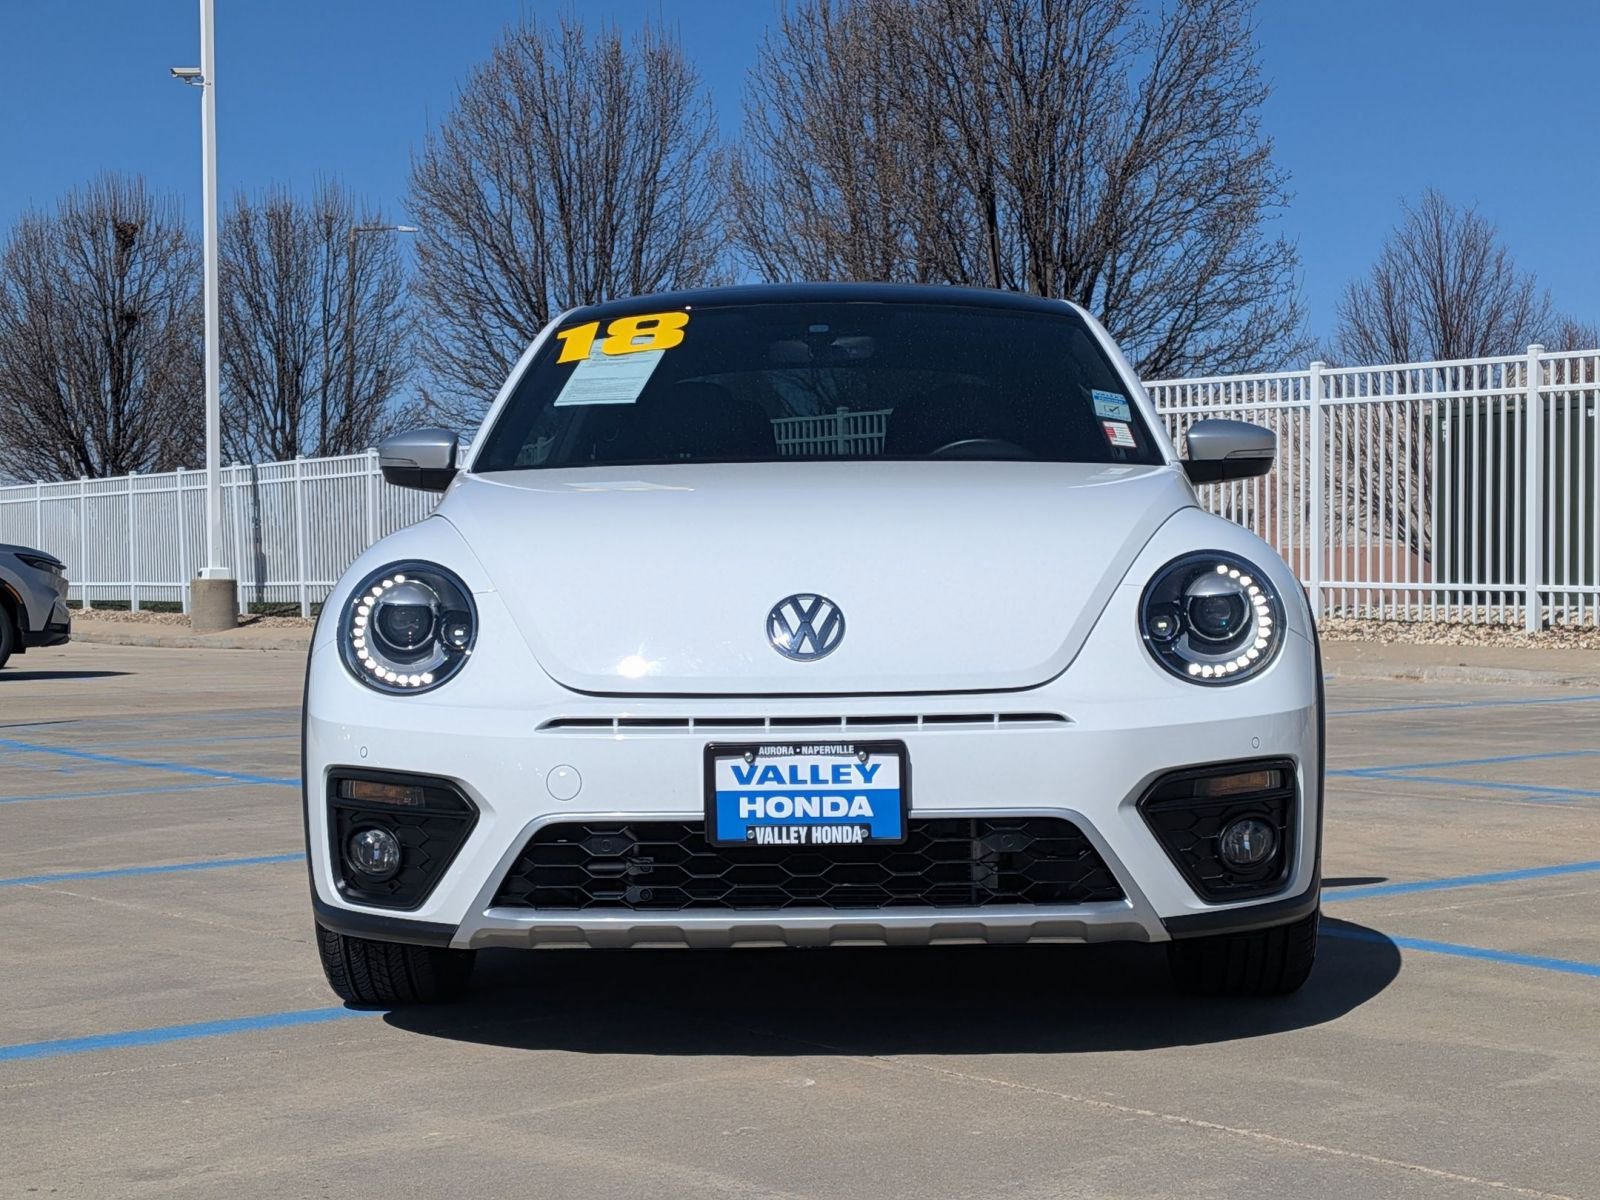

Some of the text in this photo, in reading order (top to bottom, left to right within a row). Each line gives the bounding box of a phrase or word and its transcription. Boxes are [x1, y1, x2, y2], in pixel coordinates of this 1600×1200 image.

[556, 312, 689, 364] 18
[758, 745, 854, 756] AURORA NAPERVILLE
[731, 764, 881, 785] VALLEY
[740, 796, 873, 818] HONDA
[755, 825, 863, 845] VALLEY HONDA
